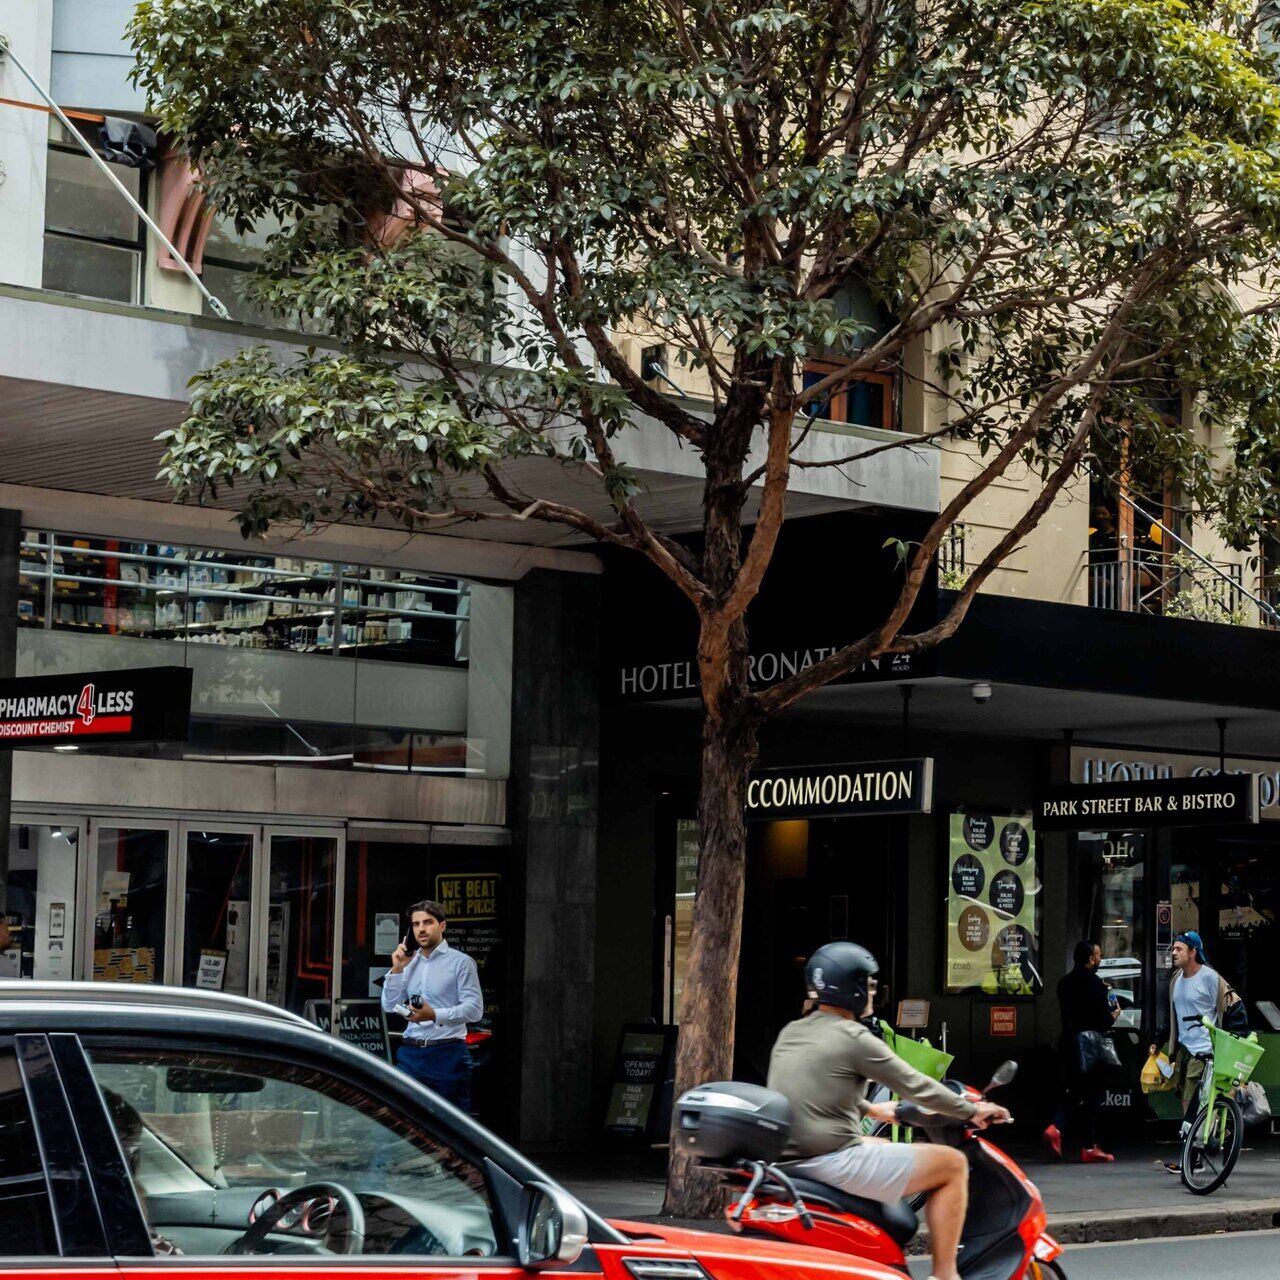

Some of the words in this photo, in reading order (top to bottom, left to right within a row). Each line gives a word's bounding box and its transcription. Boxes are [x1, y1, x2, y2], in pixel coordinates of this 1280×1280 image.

[621, 662, 697, 694] HOTEL
[0, 694, 78, 718] PHARMACY
[76, 683, 96, 726] 4
[97, 691, 134, 713] LESS
[40, 720, 75, 734] CHEMIST
[744, 770, 913, 809] CCOMMODATION
[1043, 800, 1078, 816] PARK
[1081, 798, 1131, 815] STREET
[1134, 796, 1163, 813] BAR
[1166, 795, 1178, 811] &
[1182, 792, 1235, 810] BISTRO
[441, 879, 461, 898] WE
[465, 879, 496, 898] BEAT
[466, 898, 496, 914] PRICE
[624, 1061, 656, 1069] OPENING
